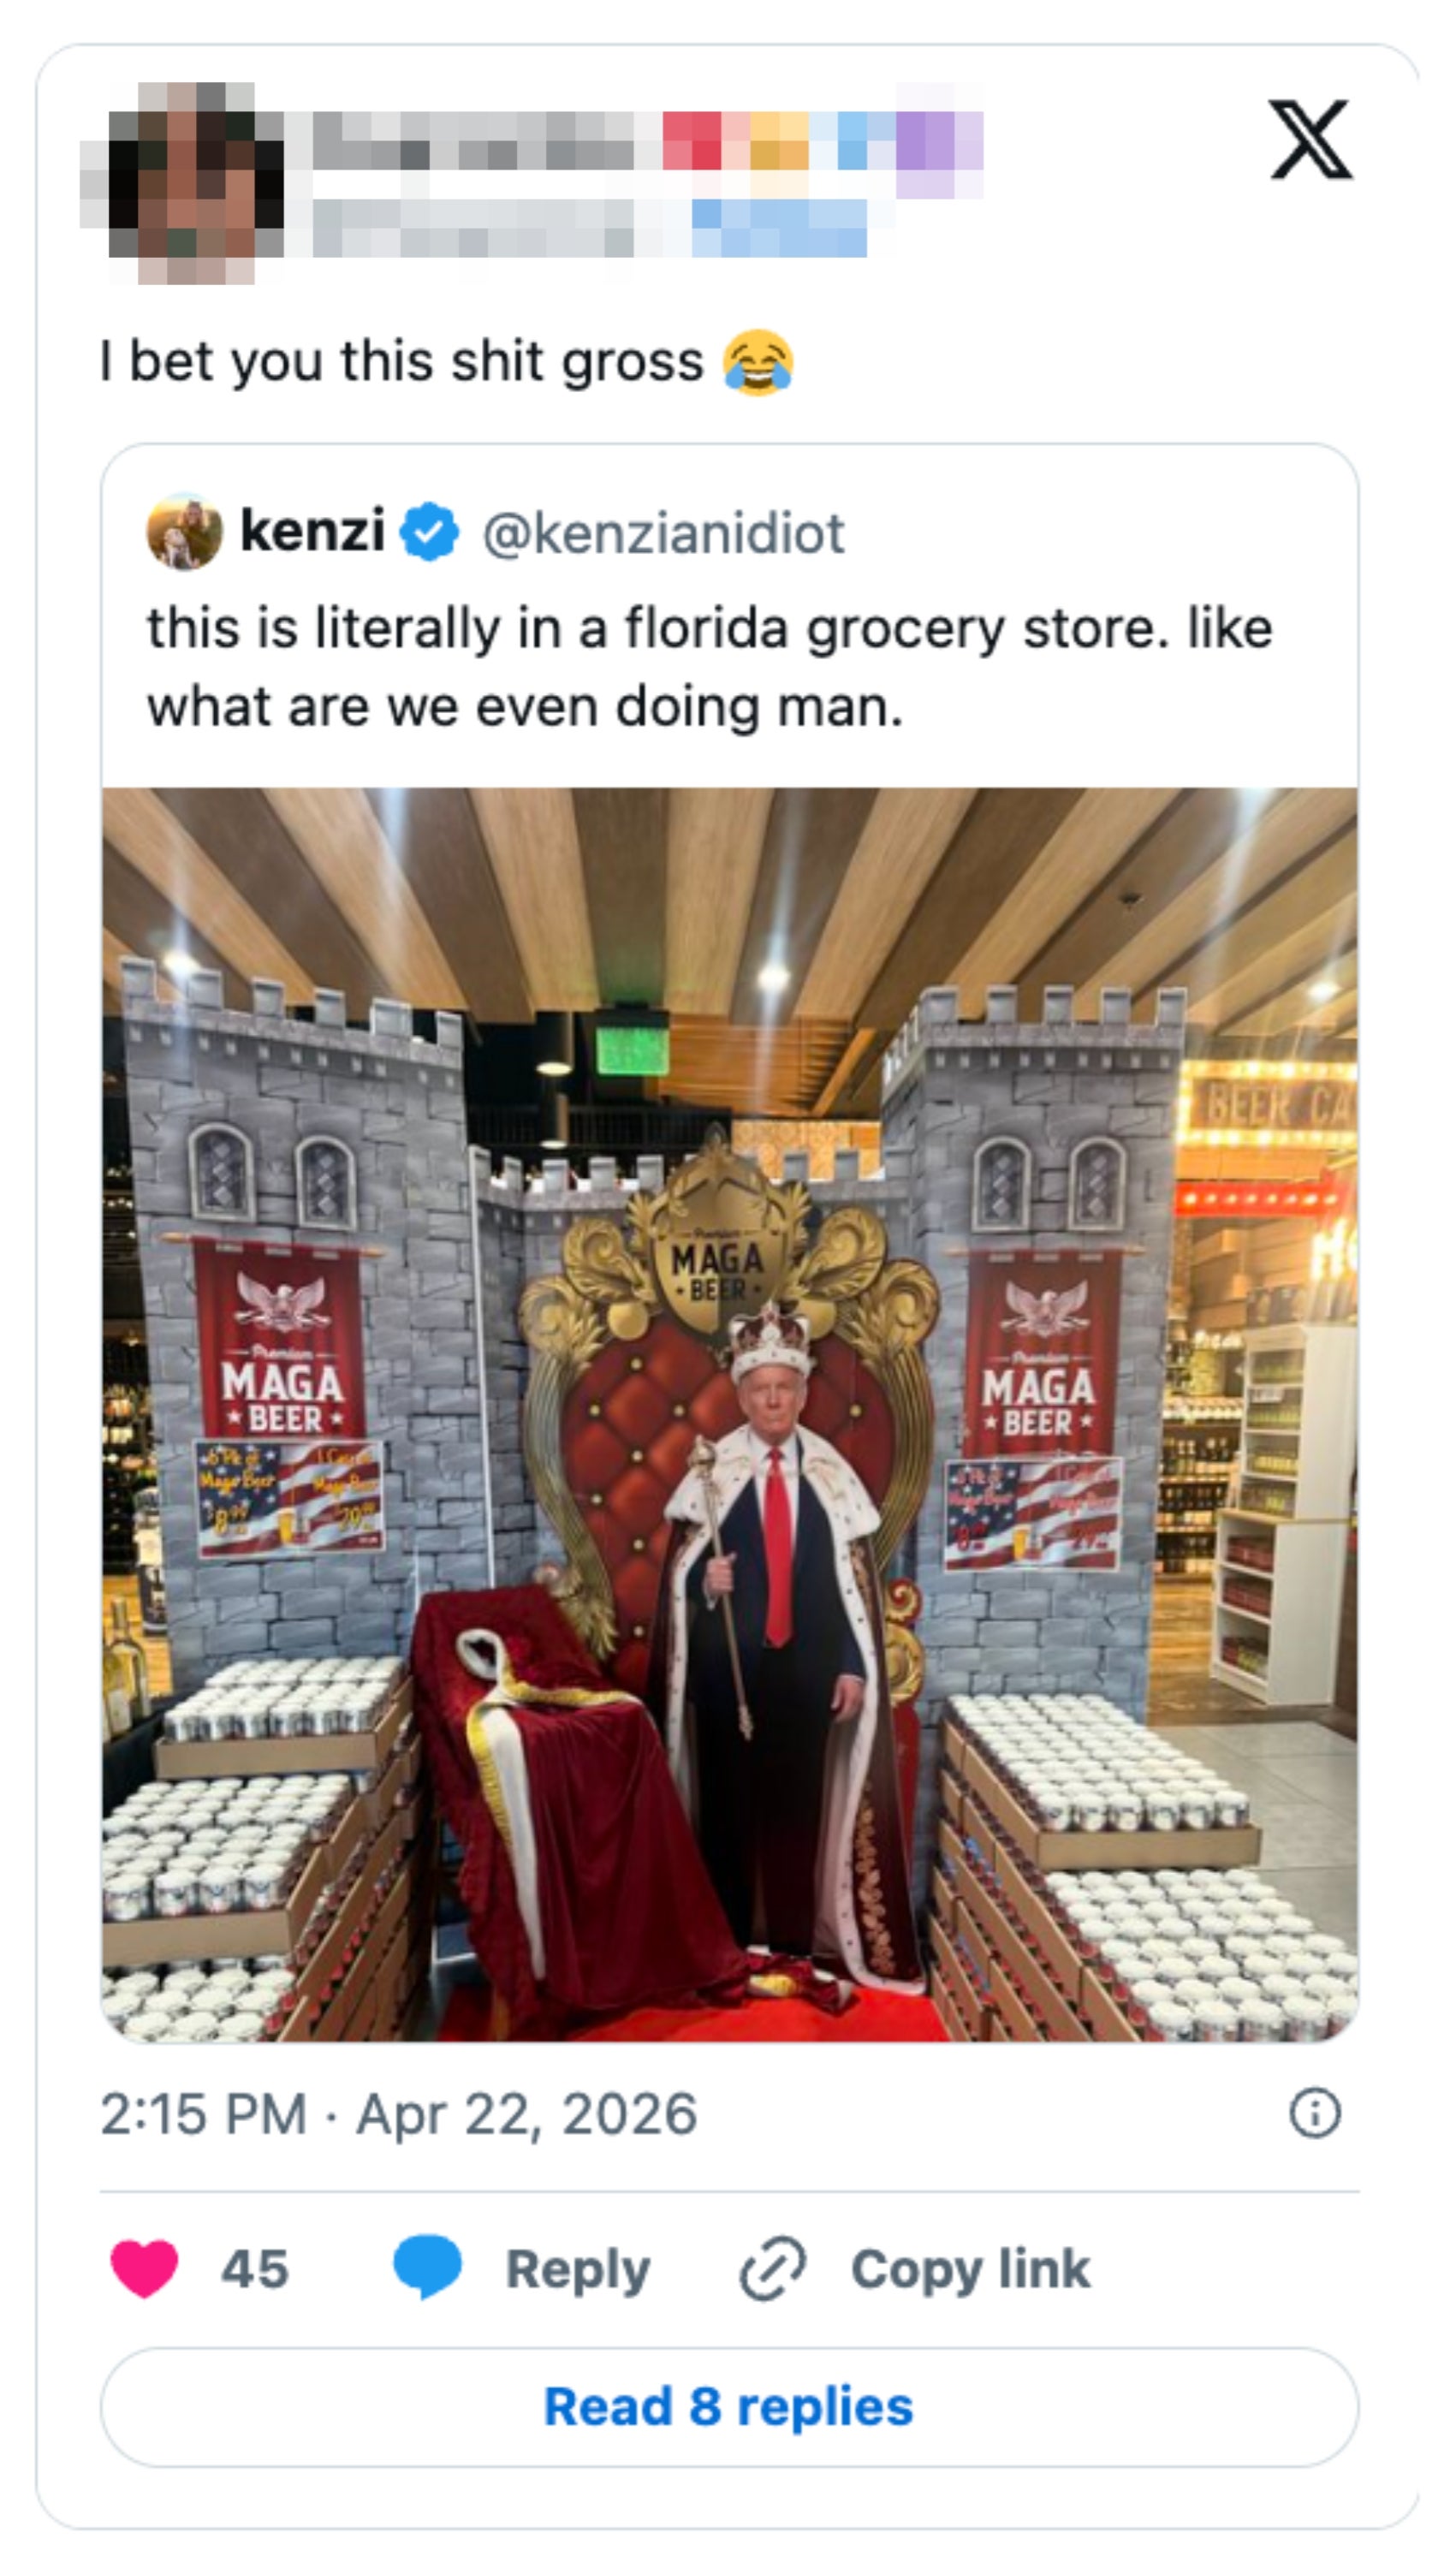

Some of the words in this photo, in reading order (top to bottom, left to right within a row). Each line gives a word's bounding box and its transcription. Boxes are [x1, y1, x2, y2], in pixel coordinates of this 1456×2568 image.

[100, 337, 111, 383] I
[132, 336, 213, 381] bet
[231, 348, 322, 392] you
[340, 336, 433, 381] this
[452, 336, 544, 381] shit
[562, 348, 704, 392] gross
[242, 504, 383, 551] kenzi
[484, 509, 845, 560] @kenzianidiot
[146, 603, 240, 648] this
[259, 603, 297, 648] is
[318, 603, 501, 658] literally
[520, 603, 561, 648] in
[579, 615, 607, 648] a
[625, 603, 787, 648] florida
[807, 615, 1006, 659] grocery
[1025, 609, 1168, 648] store.
[1190, 603, 1272, 648] like
[147, 682, 271, 727] what
[288, 693, 370, 727] are
[387, 693, 459, 727] we
[477, 693, 597, 727] even
[616, 682, 758, 737] doing
[780, 693, 901, 727] man.
[1208, 1082, 1292, 1126] BEER
[671, 1241, 764, 1276] MAGA
[690, 1278, 746, 1301] BEER
[221, 1361, 344, 1402] MAGA
[981, 1368, 1096, 1406] MAGA
[249, 1404, 323, 1432] BEER
[1002, 1408, 1073, 1436] BEER
[102, 2092, 206, 2135] 2:15
[229, 2093, 305, 2134] PM
[356, 2093, 448, 2144] Apr
[467, 2092, 540, 2144] 22,
[564, 2092, 697, 2135] 2026
[222, 2250, 288, 2289] 45
[508, 2247, 651, 2298] Reply
[853, 2249, 984, 2298] Copy
[1001, 2246, 1091, 2288] link
[545, 2384, 672, 2426] Read
[690, 2386, 722, 2427] 8
[739, 2383, 913, 2435] replies
